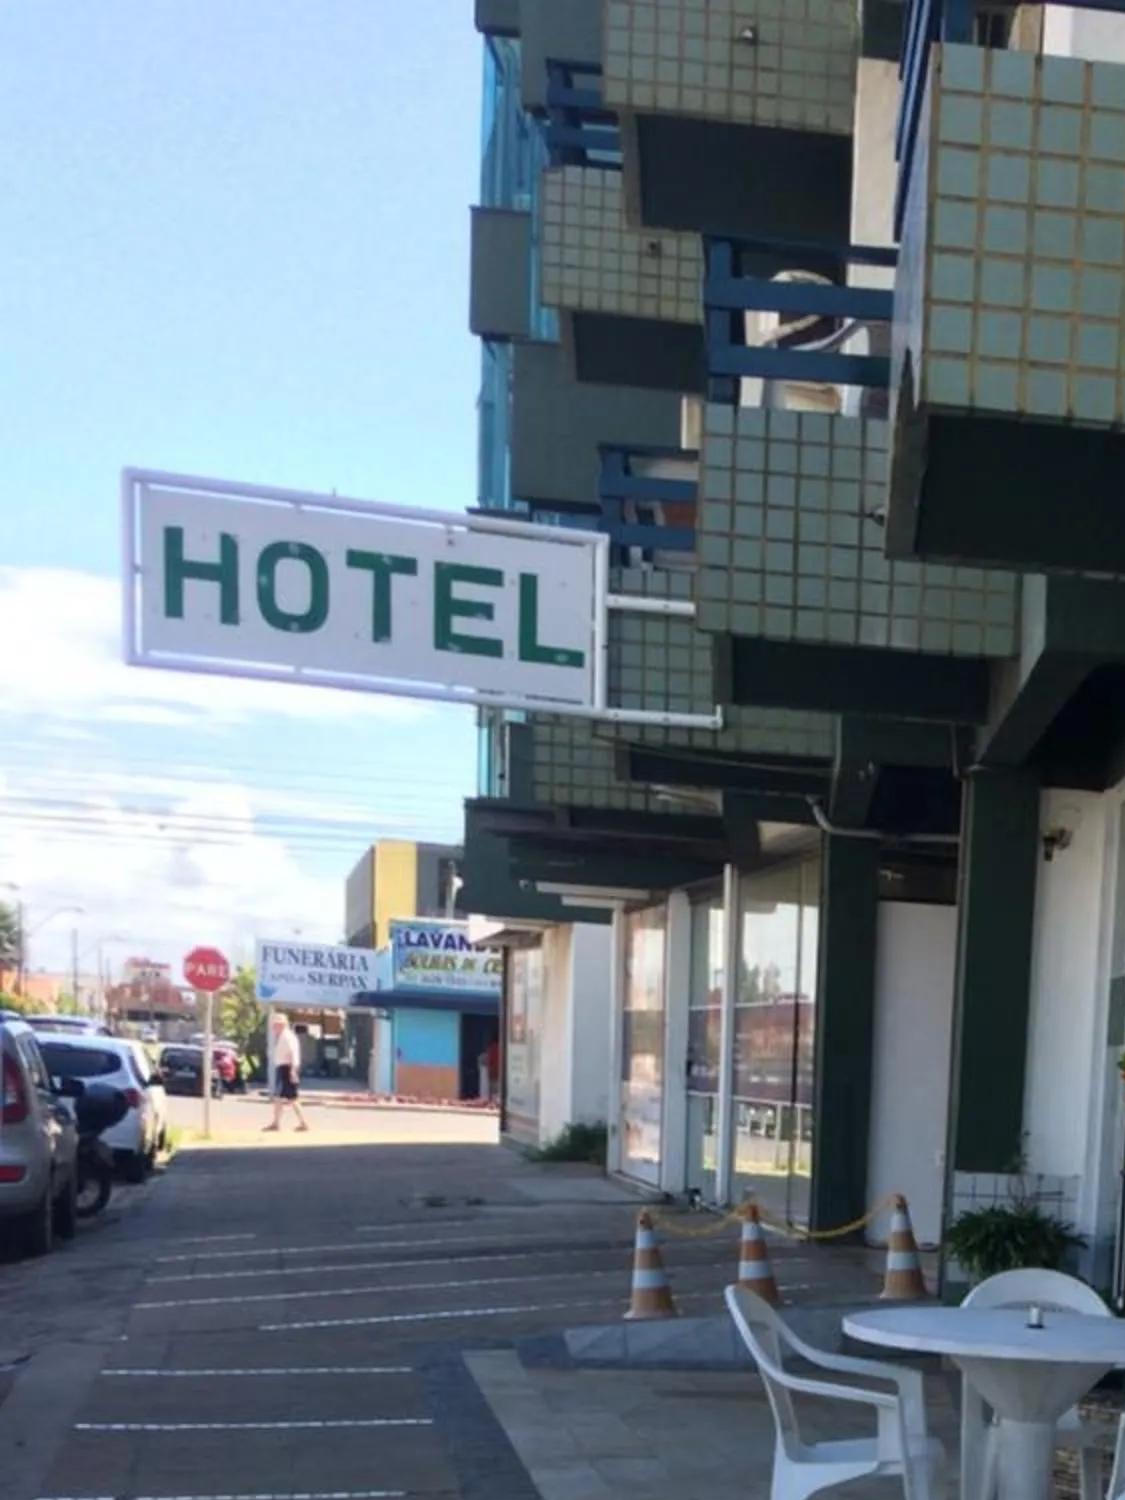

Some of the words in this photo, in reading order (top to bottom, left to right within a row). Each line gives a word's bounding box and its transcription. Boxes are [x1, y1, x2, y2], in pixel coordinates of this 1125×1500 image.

[163, 526, 585, 668] HOTEL
[404, 930, 501, 953] LAVAN
[185, 961, 228, 977] PARE
